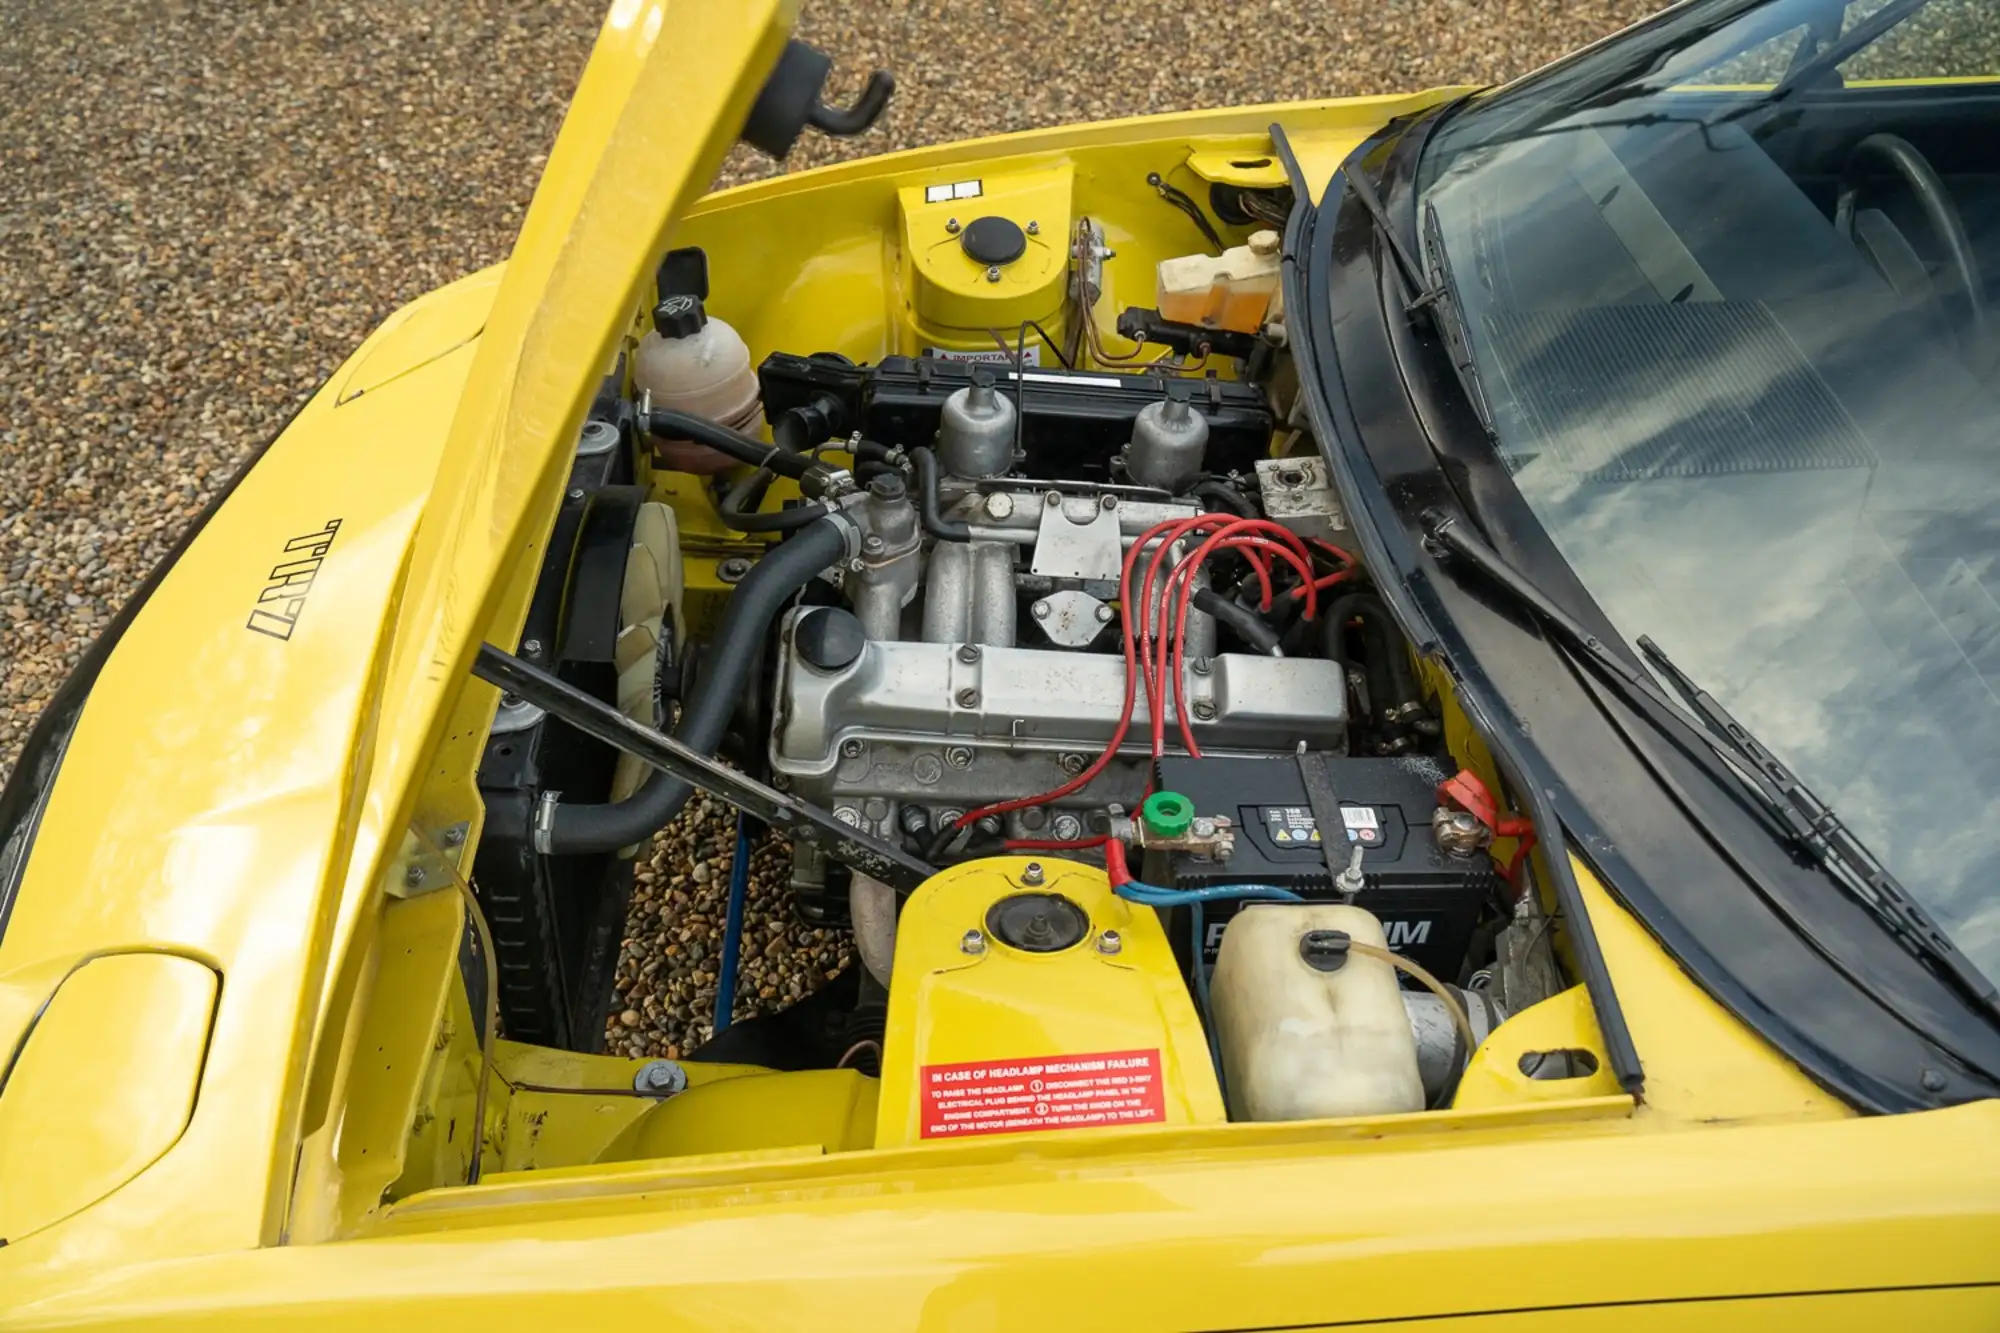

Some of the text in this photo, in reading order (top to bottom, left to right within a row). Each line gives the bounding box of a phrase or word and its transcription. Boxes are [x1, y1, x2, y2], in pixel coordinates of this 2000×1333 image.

[246, 518, 343, 641] TR7
[931, 1057, 1149, 1082] IN CASE OF HEADLAMP MECHANISM FAILURE
[931, 1090, 942, 1098] TO
[943, 1089, 965, 1098] RAISE
[968, 1087, 982, 1096] THE
[1045, 1079, 1094, 1090] DISCONNECT
[1095, 1078, 1110, 1086] THE
[1112, 1076, 1128, 1084] RED
[938, 1099, 984, 1110] ELECTRICAL
[985, 1096, 1006, 1106] PLUG
[1007, 1094, 1036, 1104] BEHIND
[1036, 1093, 1052, 1102] THE
[1053, 1090, 1094, 1100] HEADLAMP
[1096, 1088, 1120, 1098] PANEL
[1131, 1086, 1146, 1095] THE
[944, 1111, 972, 1120] ENGINE
[1051, 1104, 1072, 1112] TURN
[1073, 1102, 1088, 1111] THE
[1113, 1100, 1124, 1108] ON
[1126, 1098, 1141, 1106] THE
[930, 1124, 947, 1132] END
[960, 1122, 975, 1130] THE
[976, 1120, 1004, 1130] MOTOR
[1044, 1116, 1060, 1125] THE
[1106, 1112, 1118, 1120] TO
[1119, 1110, 1134, 1118] THE
